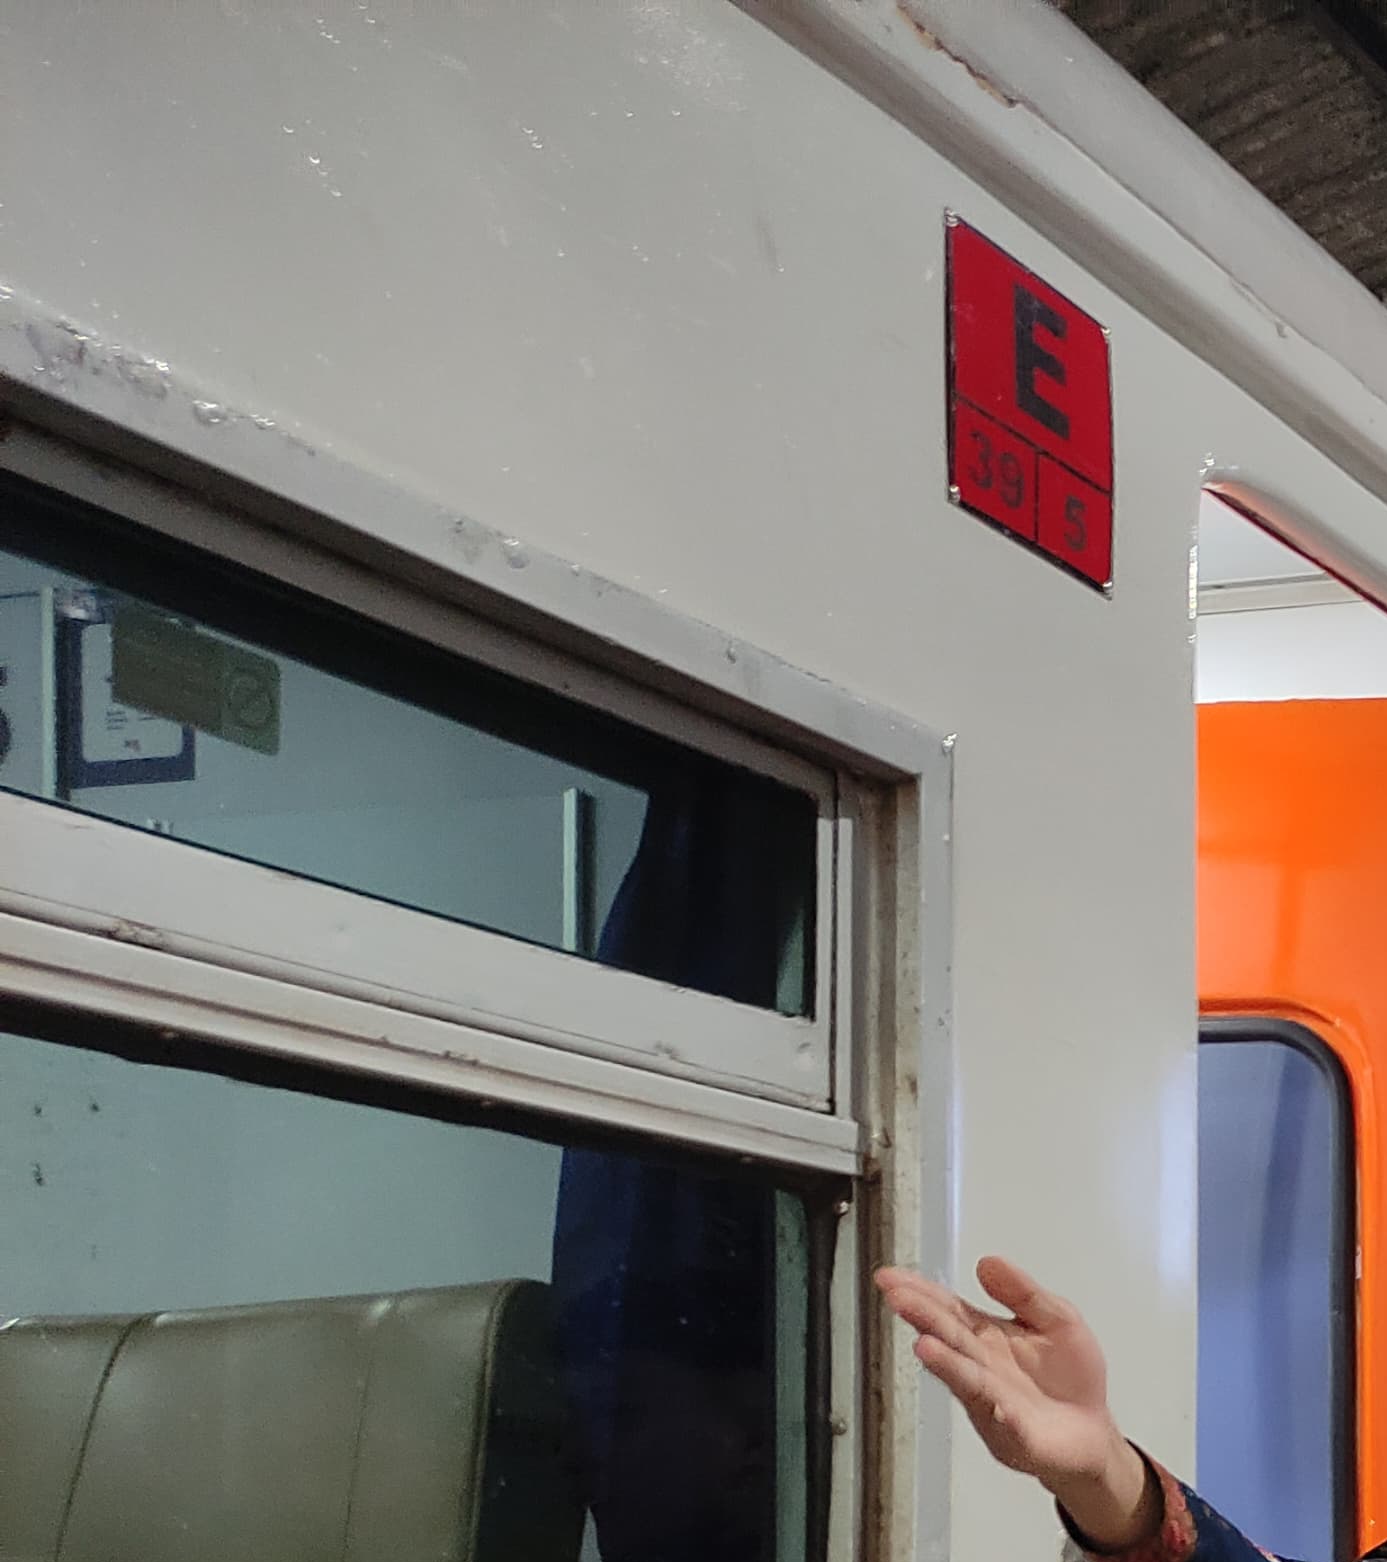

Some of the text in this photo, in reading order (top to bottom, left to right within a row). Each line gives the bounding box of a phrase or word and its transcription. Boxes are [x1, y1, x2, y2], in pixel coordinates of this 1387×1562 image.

[1013, 282, 1069, 440] E
[967, 430, 1088, 552] 39 5
